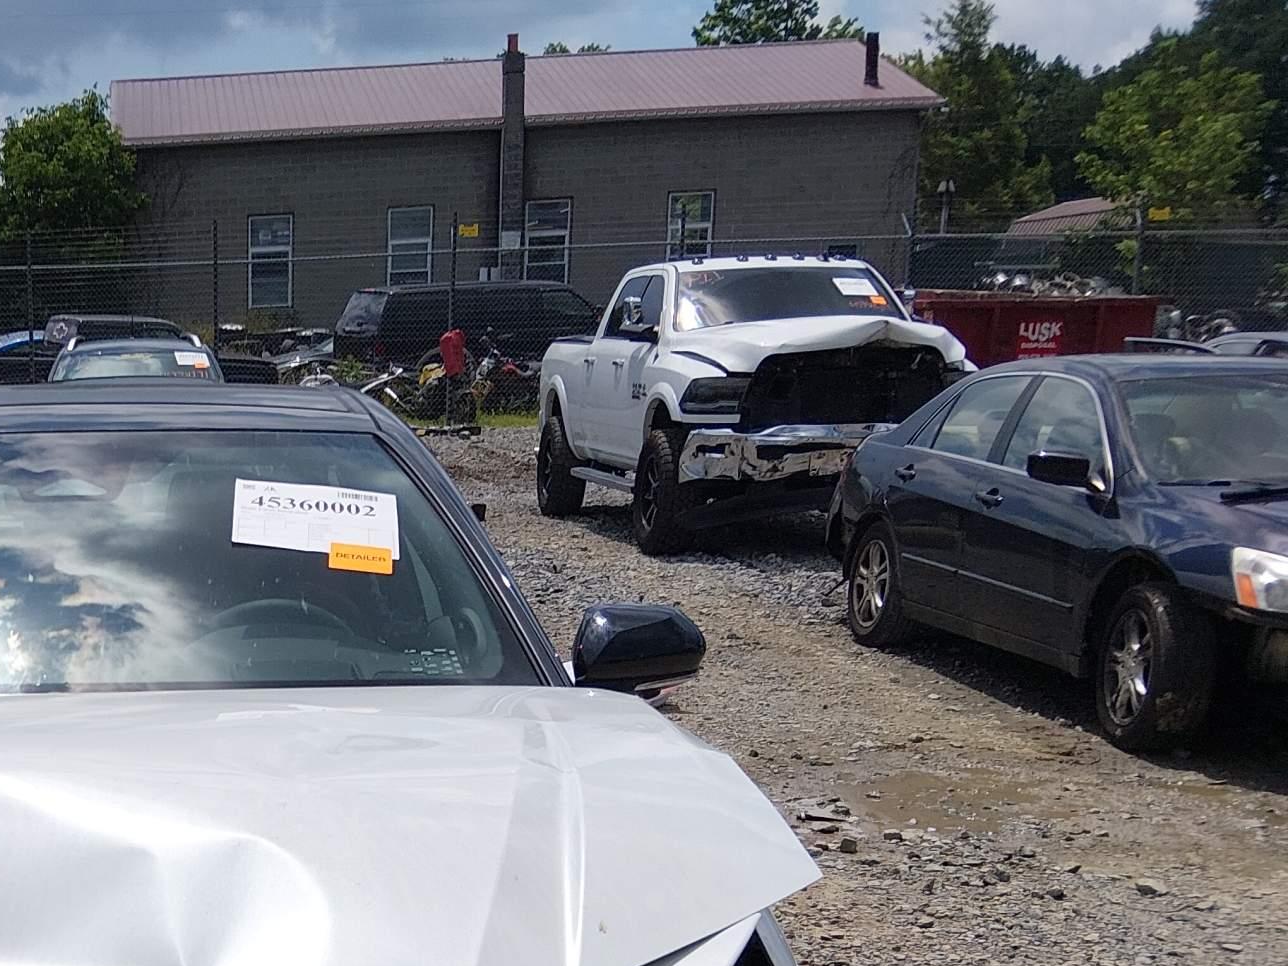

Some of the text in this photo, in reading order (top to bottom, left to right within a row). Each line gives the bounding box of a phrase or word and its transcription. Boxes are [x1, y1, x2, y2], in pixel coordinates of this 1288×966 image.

[1019, 322, 1063, 341] LUSK
[251, 495, 377, 517] 45360002
[335, 551, 387, 563] DETAILER
